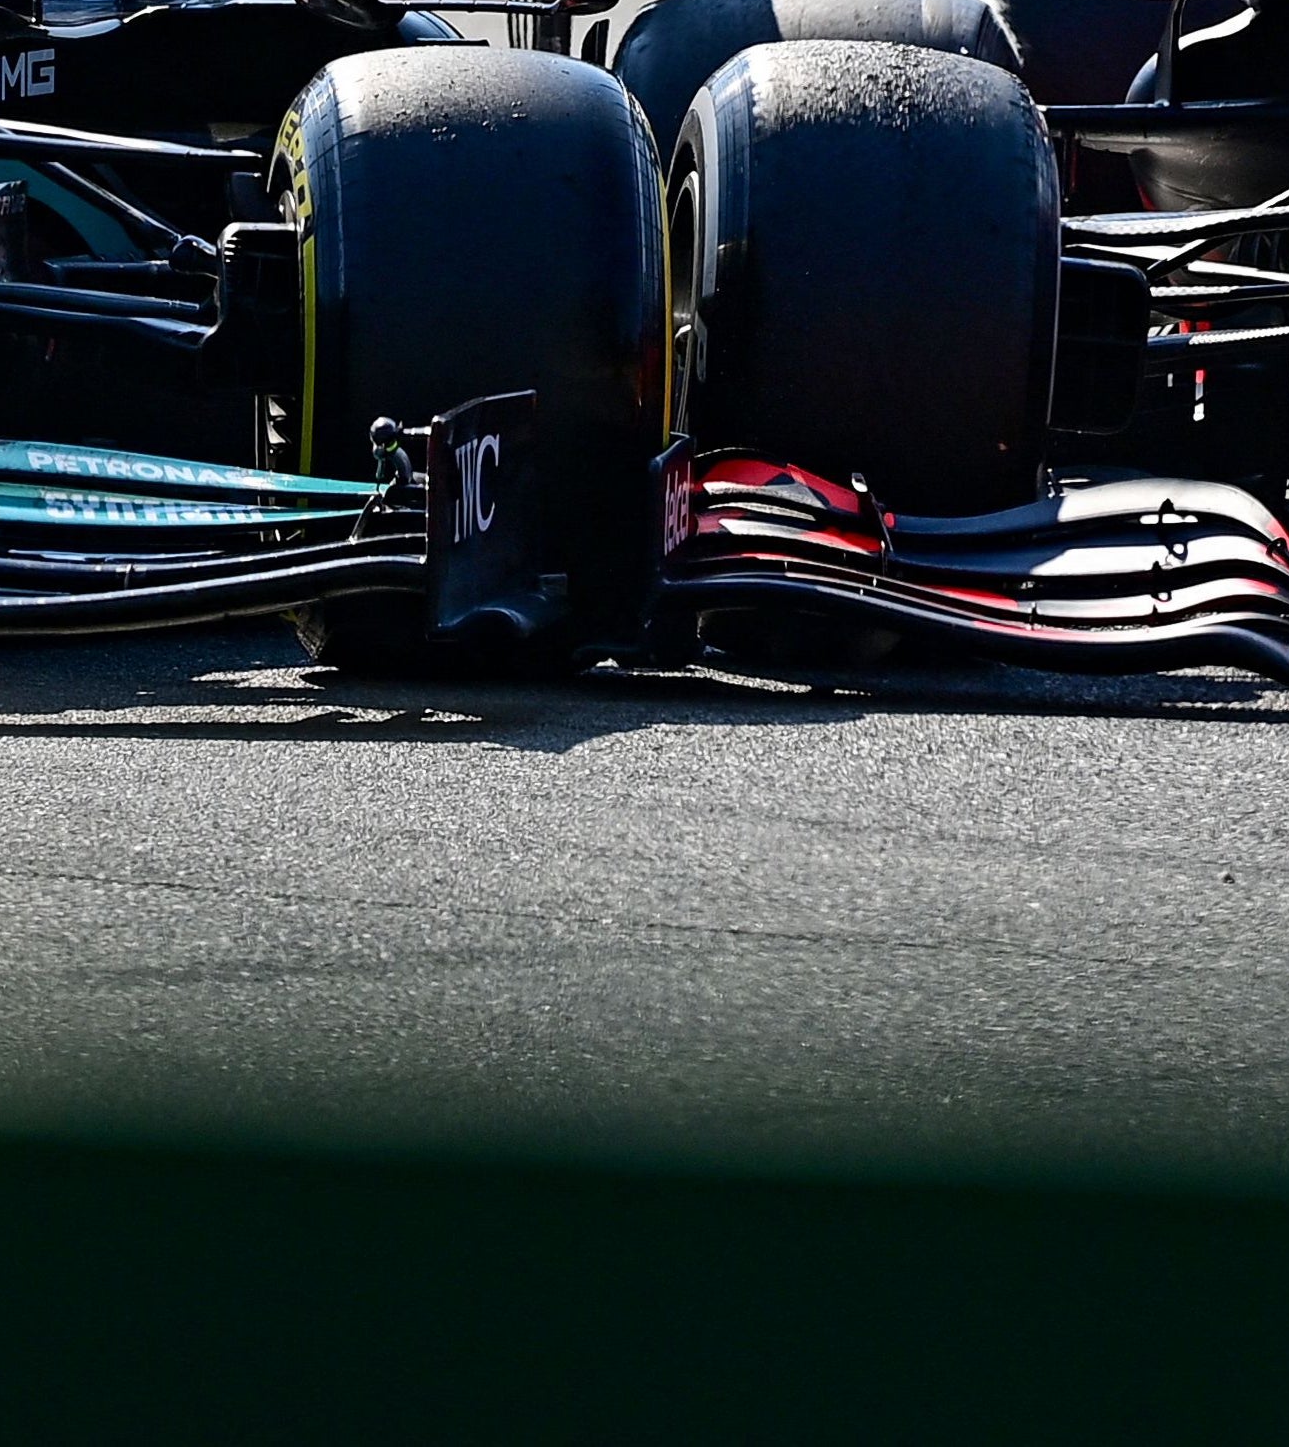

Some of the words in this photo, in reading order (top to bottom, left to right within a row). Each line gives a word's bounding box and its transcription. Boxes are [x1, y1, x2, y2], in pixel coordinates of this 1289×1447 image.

[27, 450, 253, 486] PETRONAS
[453, 433, 500, 544] IWC
[664, 460, 691, 557] telcel
